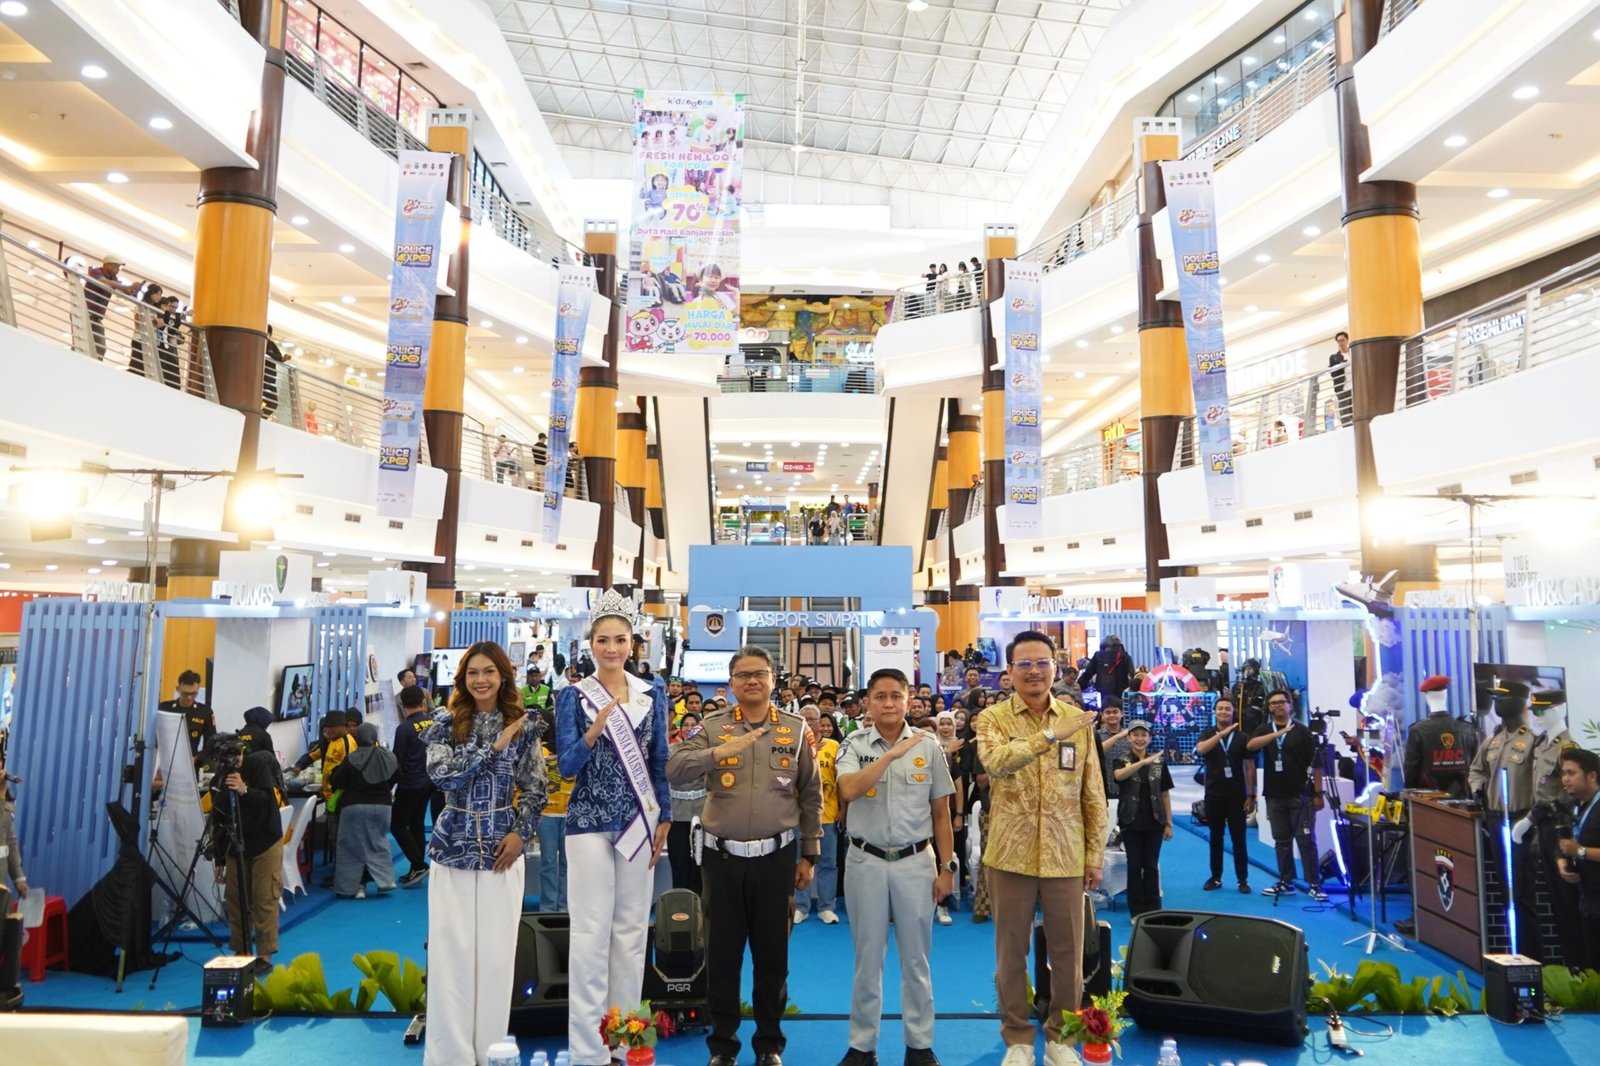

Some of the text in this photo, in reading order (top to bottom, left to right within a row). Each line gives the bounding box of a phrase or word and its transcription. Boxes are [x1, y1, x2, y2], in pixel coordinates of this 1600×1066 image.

[679, 153, 703, 161] NEW
[637, 228, 659, 236] Duta
[396, 245, 433, 254] POLICE
[395, 253, 431, 262] EXPO
[1183, 253, 1218, 264] POLICE
[1185, 262, 1218, 272] EXPO
[688, 310, 726, 320] HARGA
[685, 320, 712, 330] MULAI
[1198, 351, 1226, 362] POLIC
[380, 447, 410, 457] OLICE
[379, 455, 409, 466] XPO
[747, 612, 881, 627] PASPOR SIMPATIK
[623, 746, 644, 780] KALSEL
[667, 983, 692, 993] PGR
